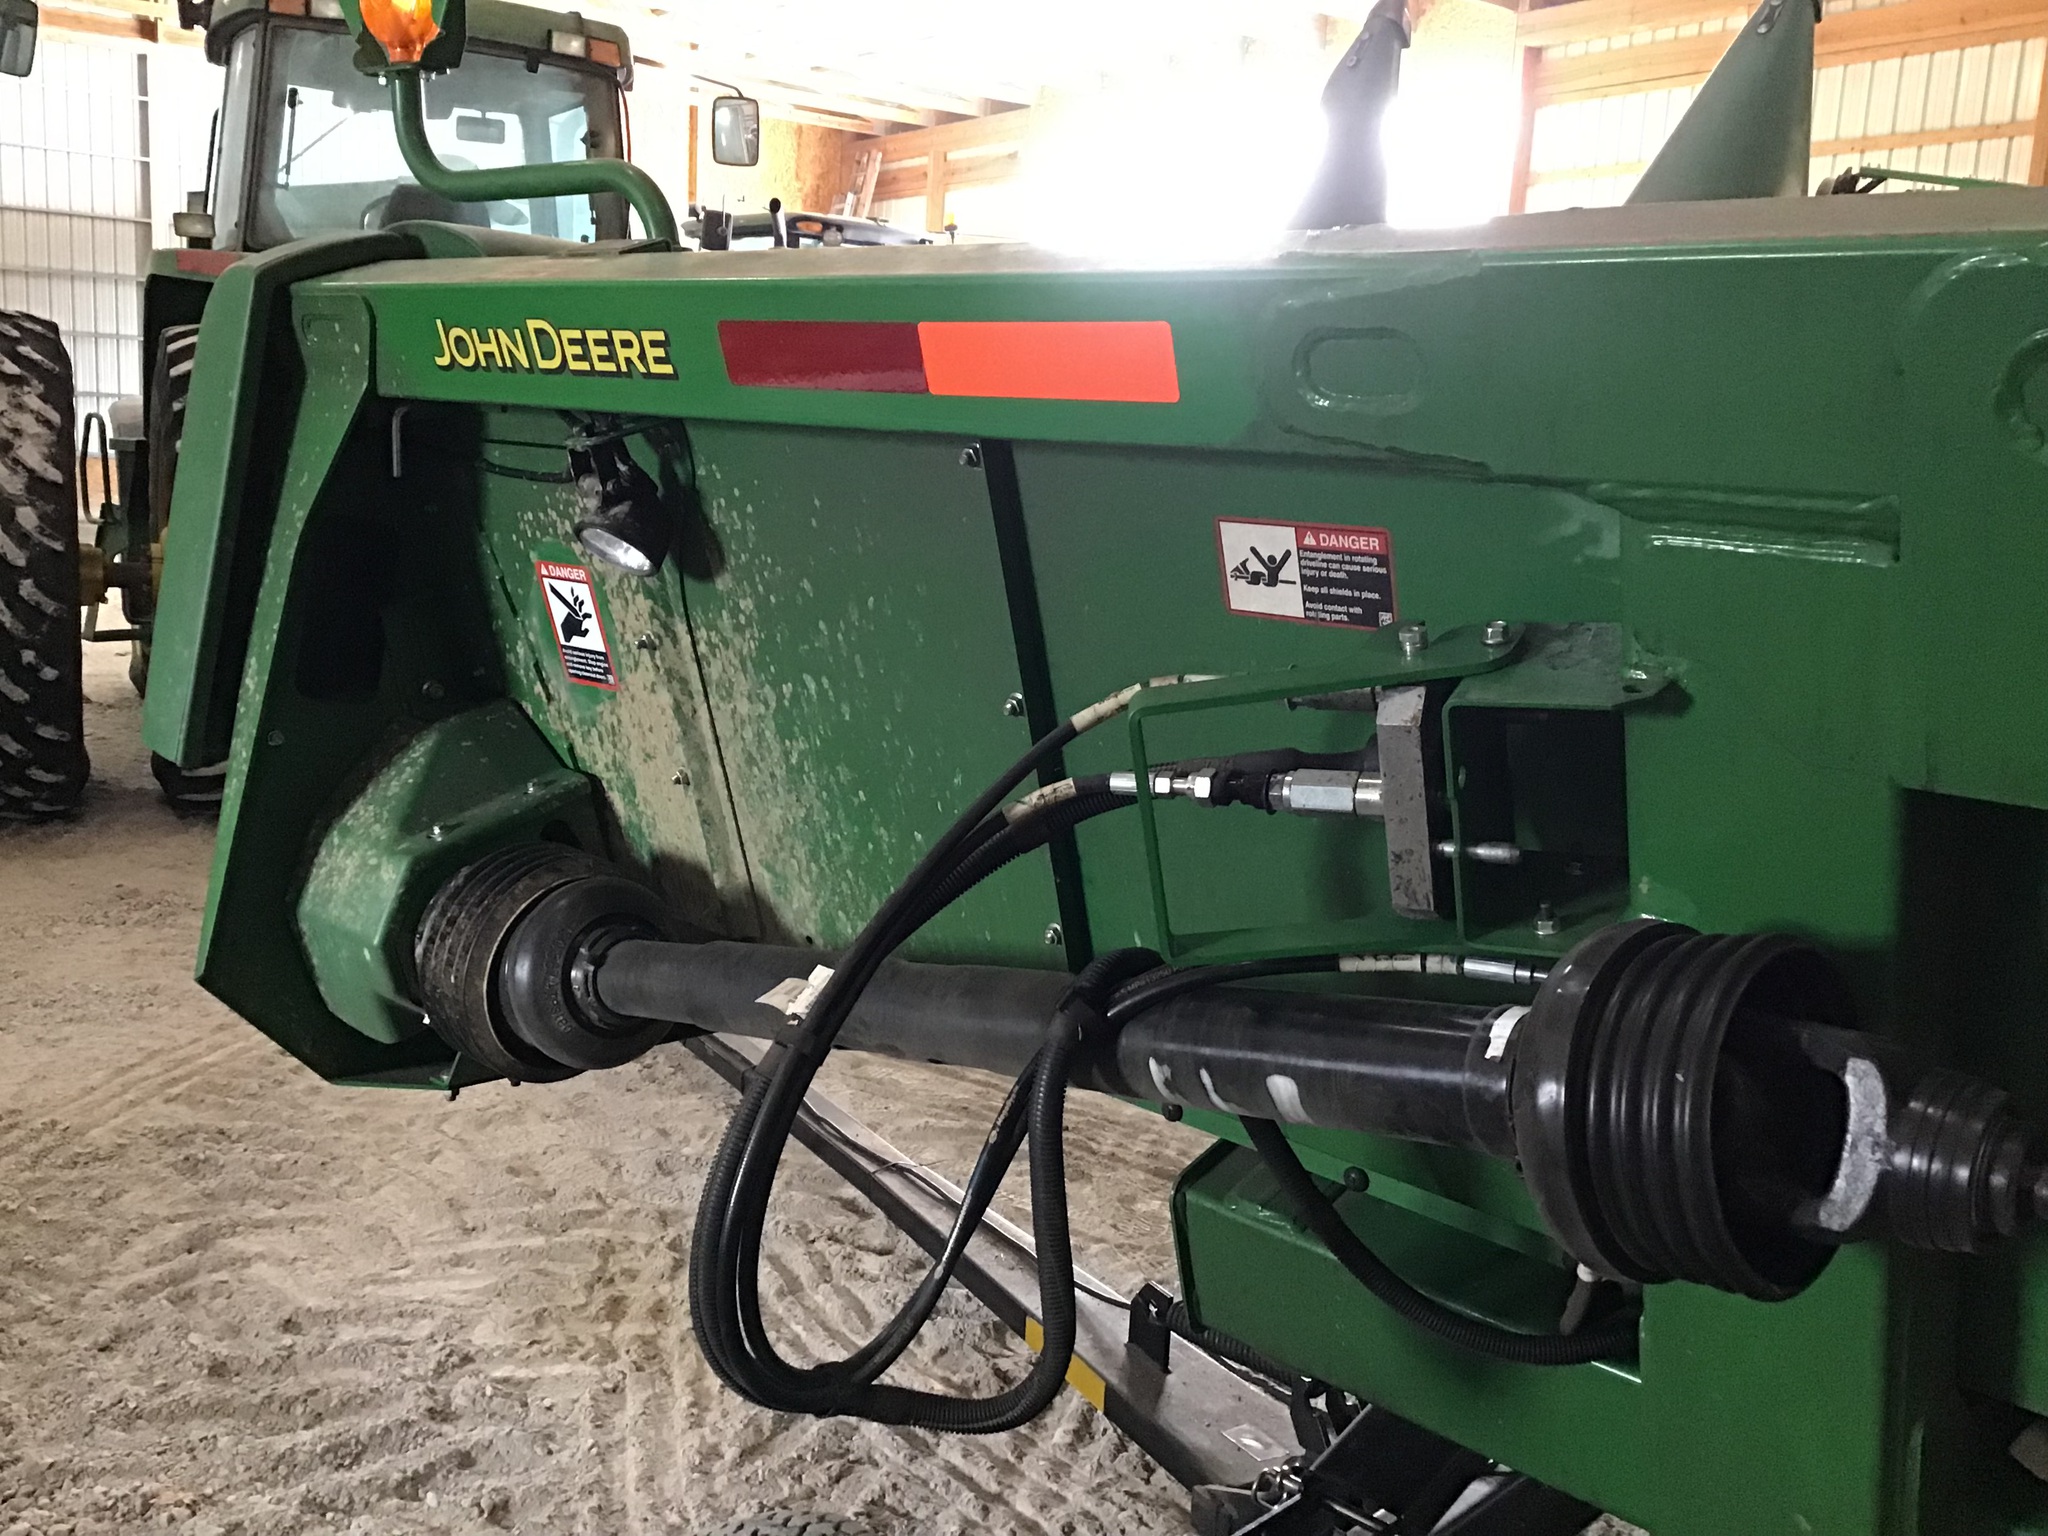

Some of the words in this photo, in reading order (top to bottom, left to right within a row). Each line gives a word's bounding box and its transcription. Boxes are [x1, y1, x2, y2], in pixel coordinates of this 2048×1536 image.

[434, 318, 533, 371] JOHN
[525, 318, 677, 378] DEERE
[1319, 534, 1380, 551] DANGER
[1299, 550, 1343, 561] Entanglement
[1343, 553, 1351, 561] in
[1352, 555, 1378, 566] rotating
[548, 565, 587, 581] DANGER
[1300, 559, 1328, 568] driveline
[1328, 562, 1340, 570] can
[1341, 563, 1361, 572] cause
[1362, 565, 1388, 574] serious
[1301, 567, 1319, 578] injury
[1328, 570, 1349, 579] death.
[1303, 584, 1319, 594] Keep
[1320, 586, 1328, 594] all
[1329, 587, 1353, 597] shields
[1353, 589, 1361, 597] in
[1361, 591, 1382, 600] place.
[1305, 601, 1323, 610] Avoid
[1324, 604, 1348, 613] contact
[1348, 606, 1363, 614] with
[1331, 613, 1350, 622] parts.
